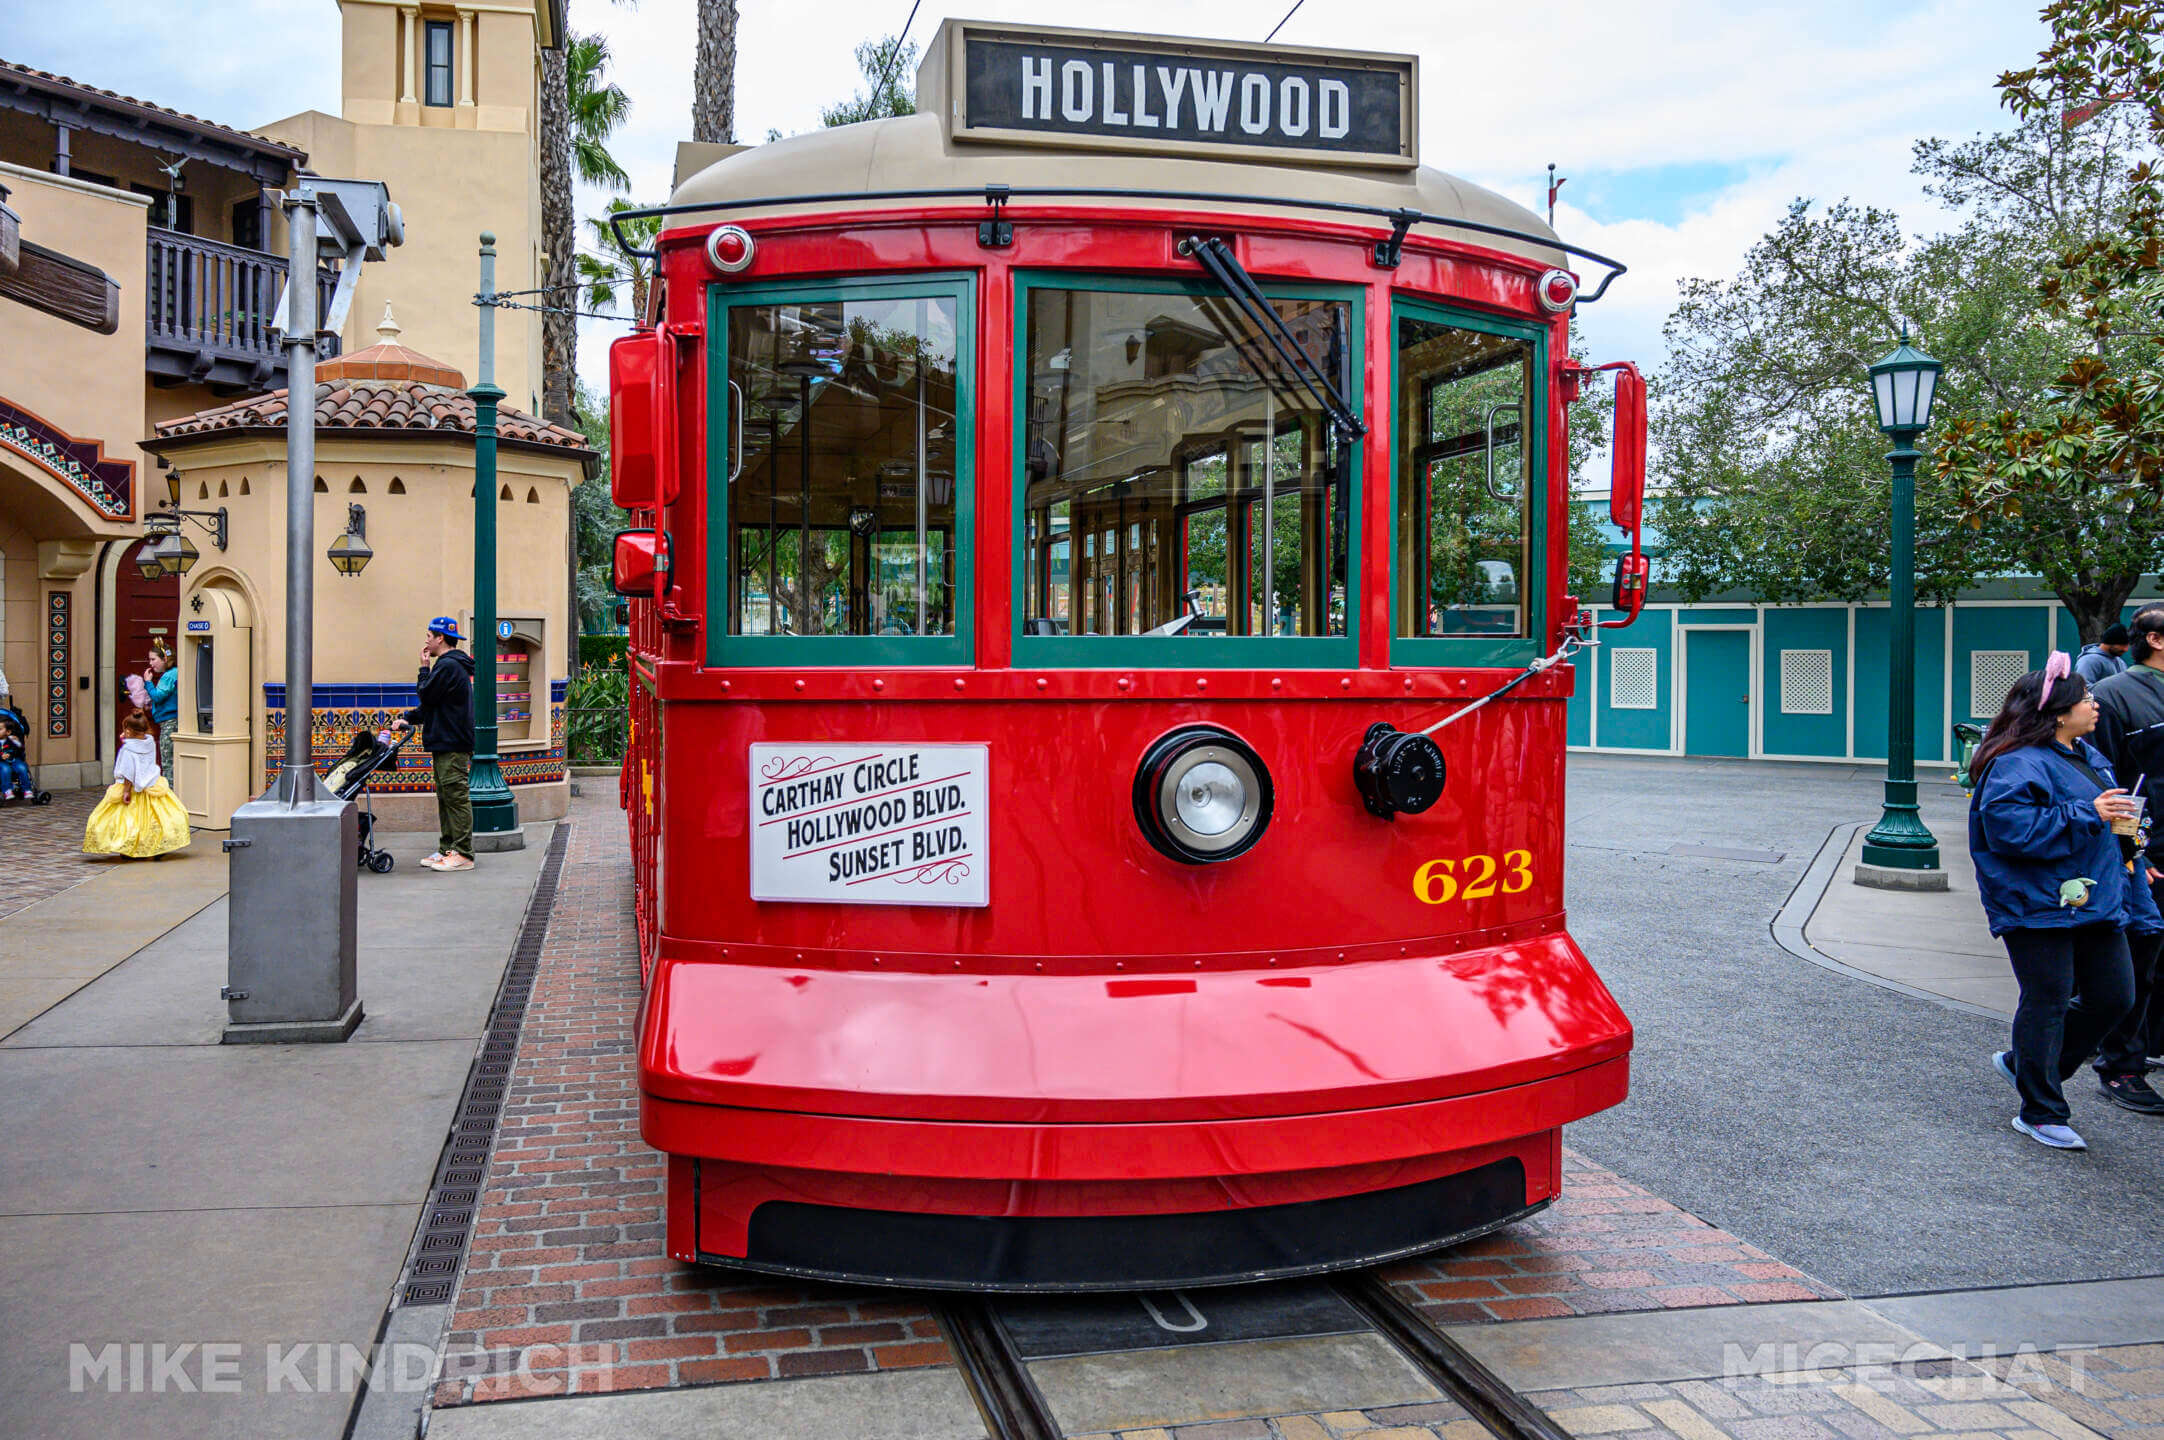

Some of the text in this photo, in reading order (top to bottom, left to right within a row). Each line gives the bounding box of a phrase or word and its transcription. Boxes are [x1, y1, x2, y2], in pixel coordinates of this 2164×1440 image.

[1022, 56, 1350, 139] HOLLYWOOD
[788, 798, 906, 850] HOLLYWOOD
[829, 840, 904, 882] SUNSET
[1412, 849, 1534, 904] 623
